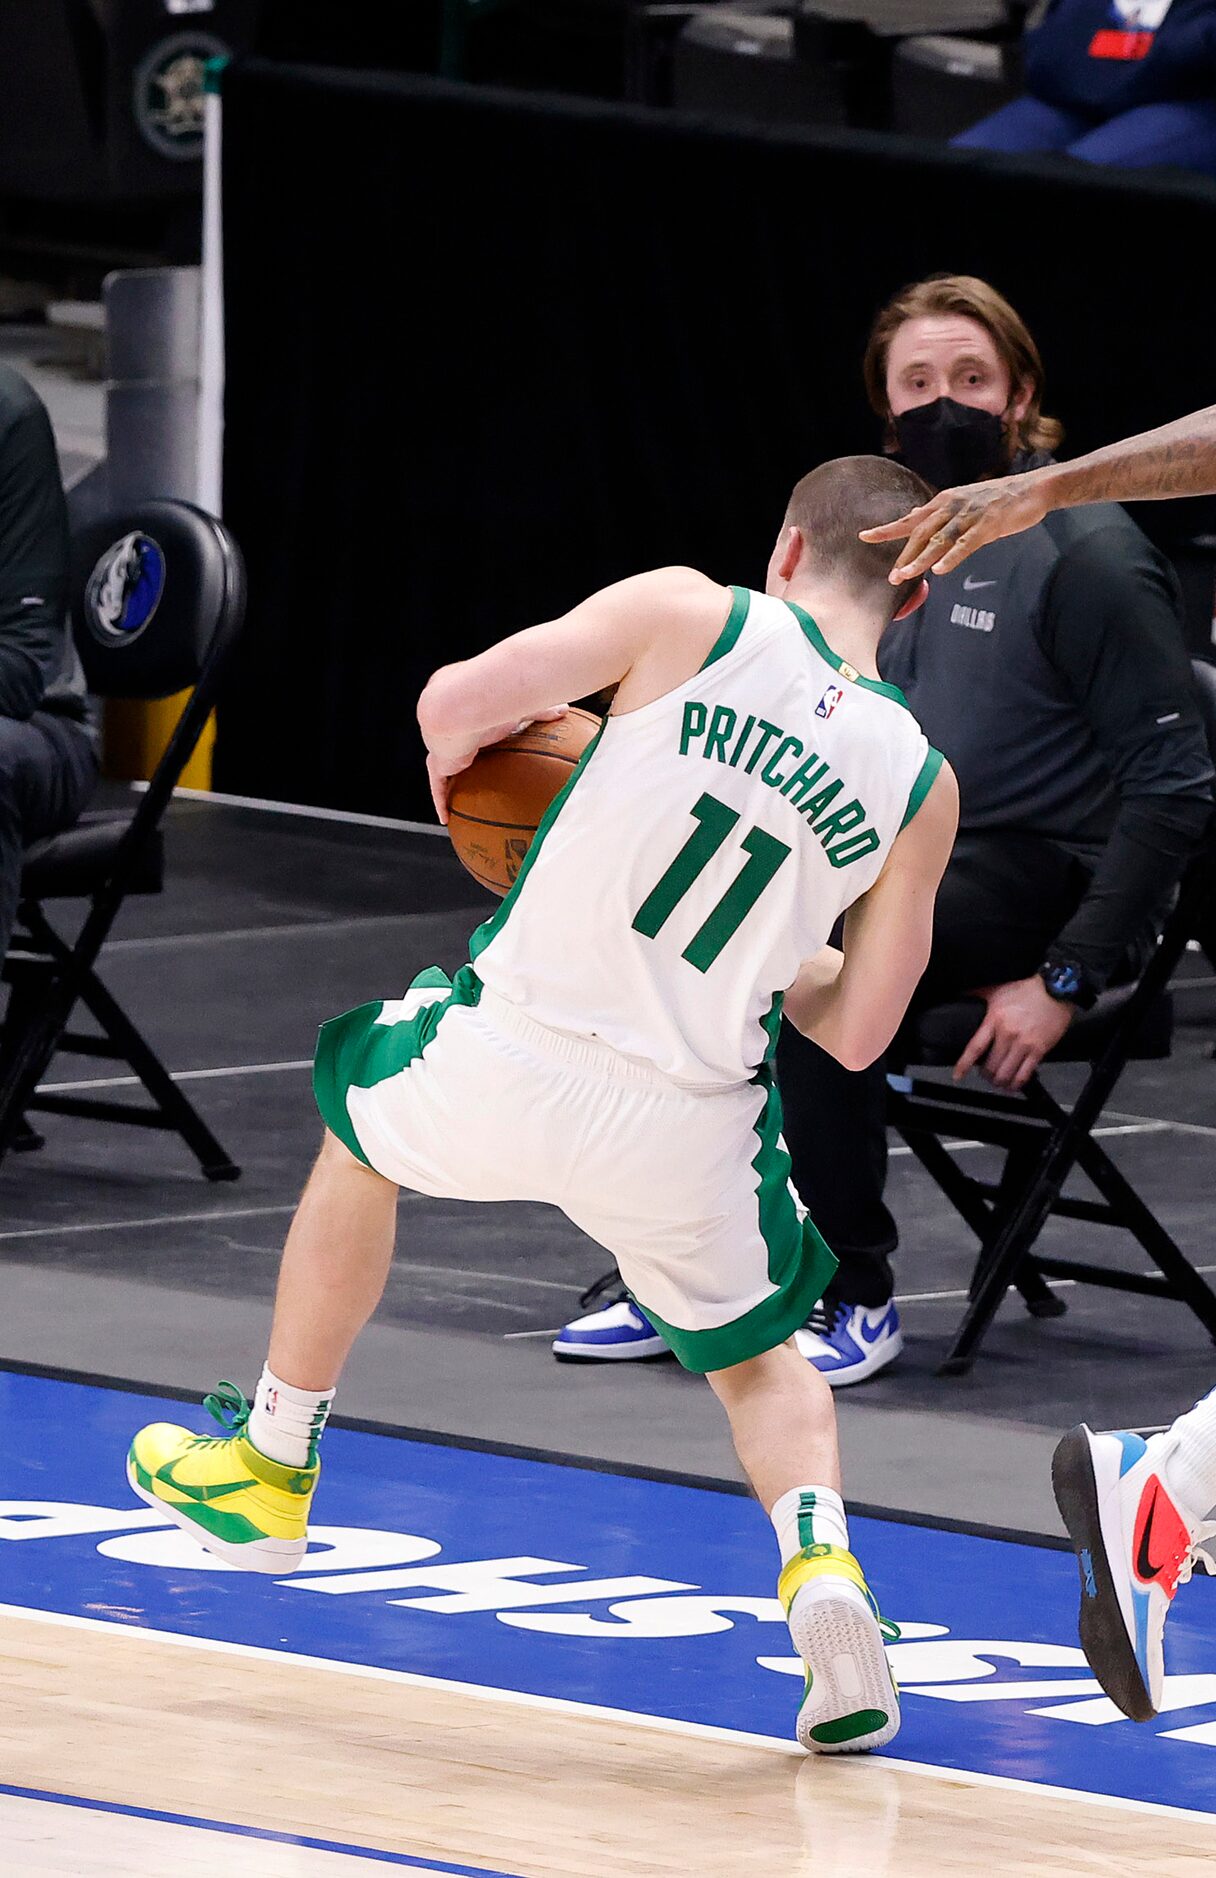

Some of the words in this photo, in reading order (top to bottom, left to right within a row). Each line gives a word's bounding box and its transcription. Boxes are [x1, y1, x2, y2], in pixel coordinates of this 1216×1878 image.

[950, 603, 996, 632] DALLAS
[679, 701, 881, 869] PRITCHARD
[631, 792, 792, 974] 11
